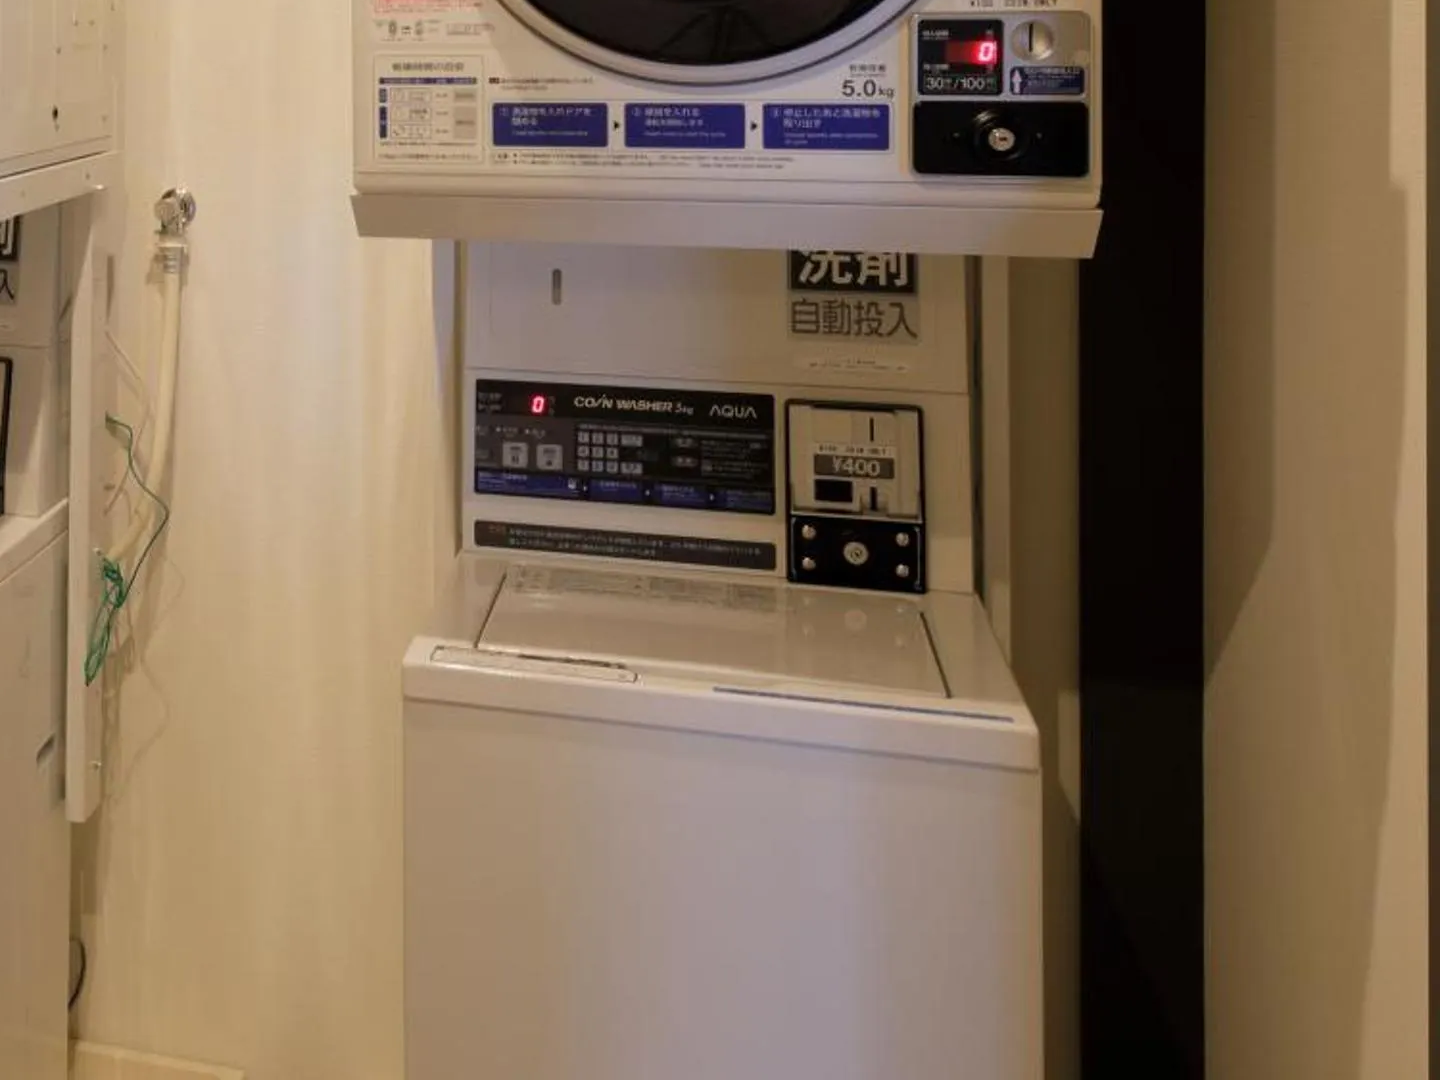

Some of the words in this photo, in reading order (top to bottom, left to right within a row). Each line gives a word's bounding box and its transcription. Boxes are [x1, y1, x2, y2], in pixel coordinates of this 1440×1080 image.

[979, 40, 994, 62] 0
[791, 298, 918, 339] 自動投入
[531, 395, 545, 414] 0
[574, 394, 612, 409] COIN
[616, 398, 673, 413] WASHER
[710, 405, 757, 419] AQUA
[832, 456, 880, 476] ¥400
